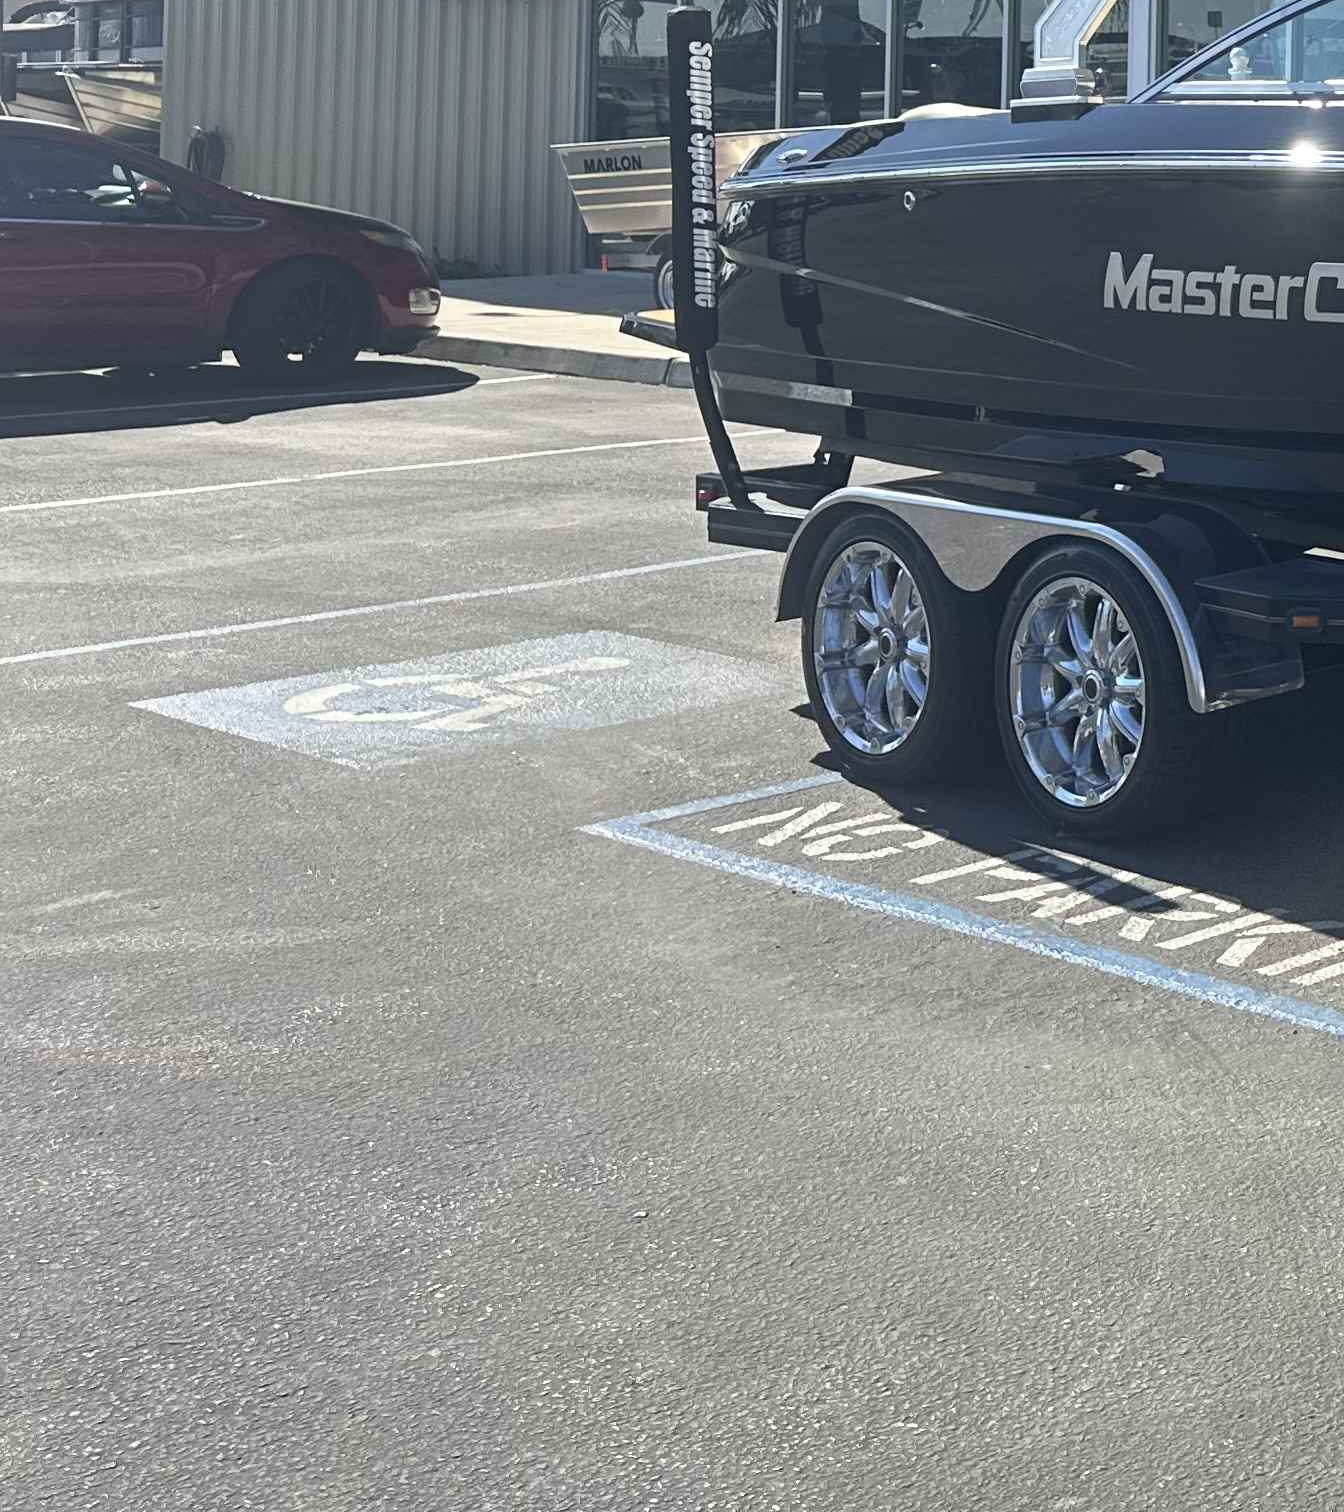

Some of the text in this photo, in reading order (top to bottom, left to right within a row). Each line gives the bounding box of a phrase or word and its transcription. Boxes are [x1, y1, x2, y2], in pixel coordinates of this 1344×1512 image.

[686, 40, 713, 132] Semper
[583, 155, 642, 174] MARLON
[688, 133, 716, 203] Speed
[692, 206, 716, 225] &
[710, 801, 949, 864] NO
